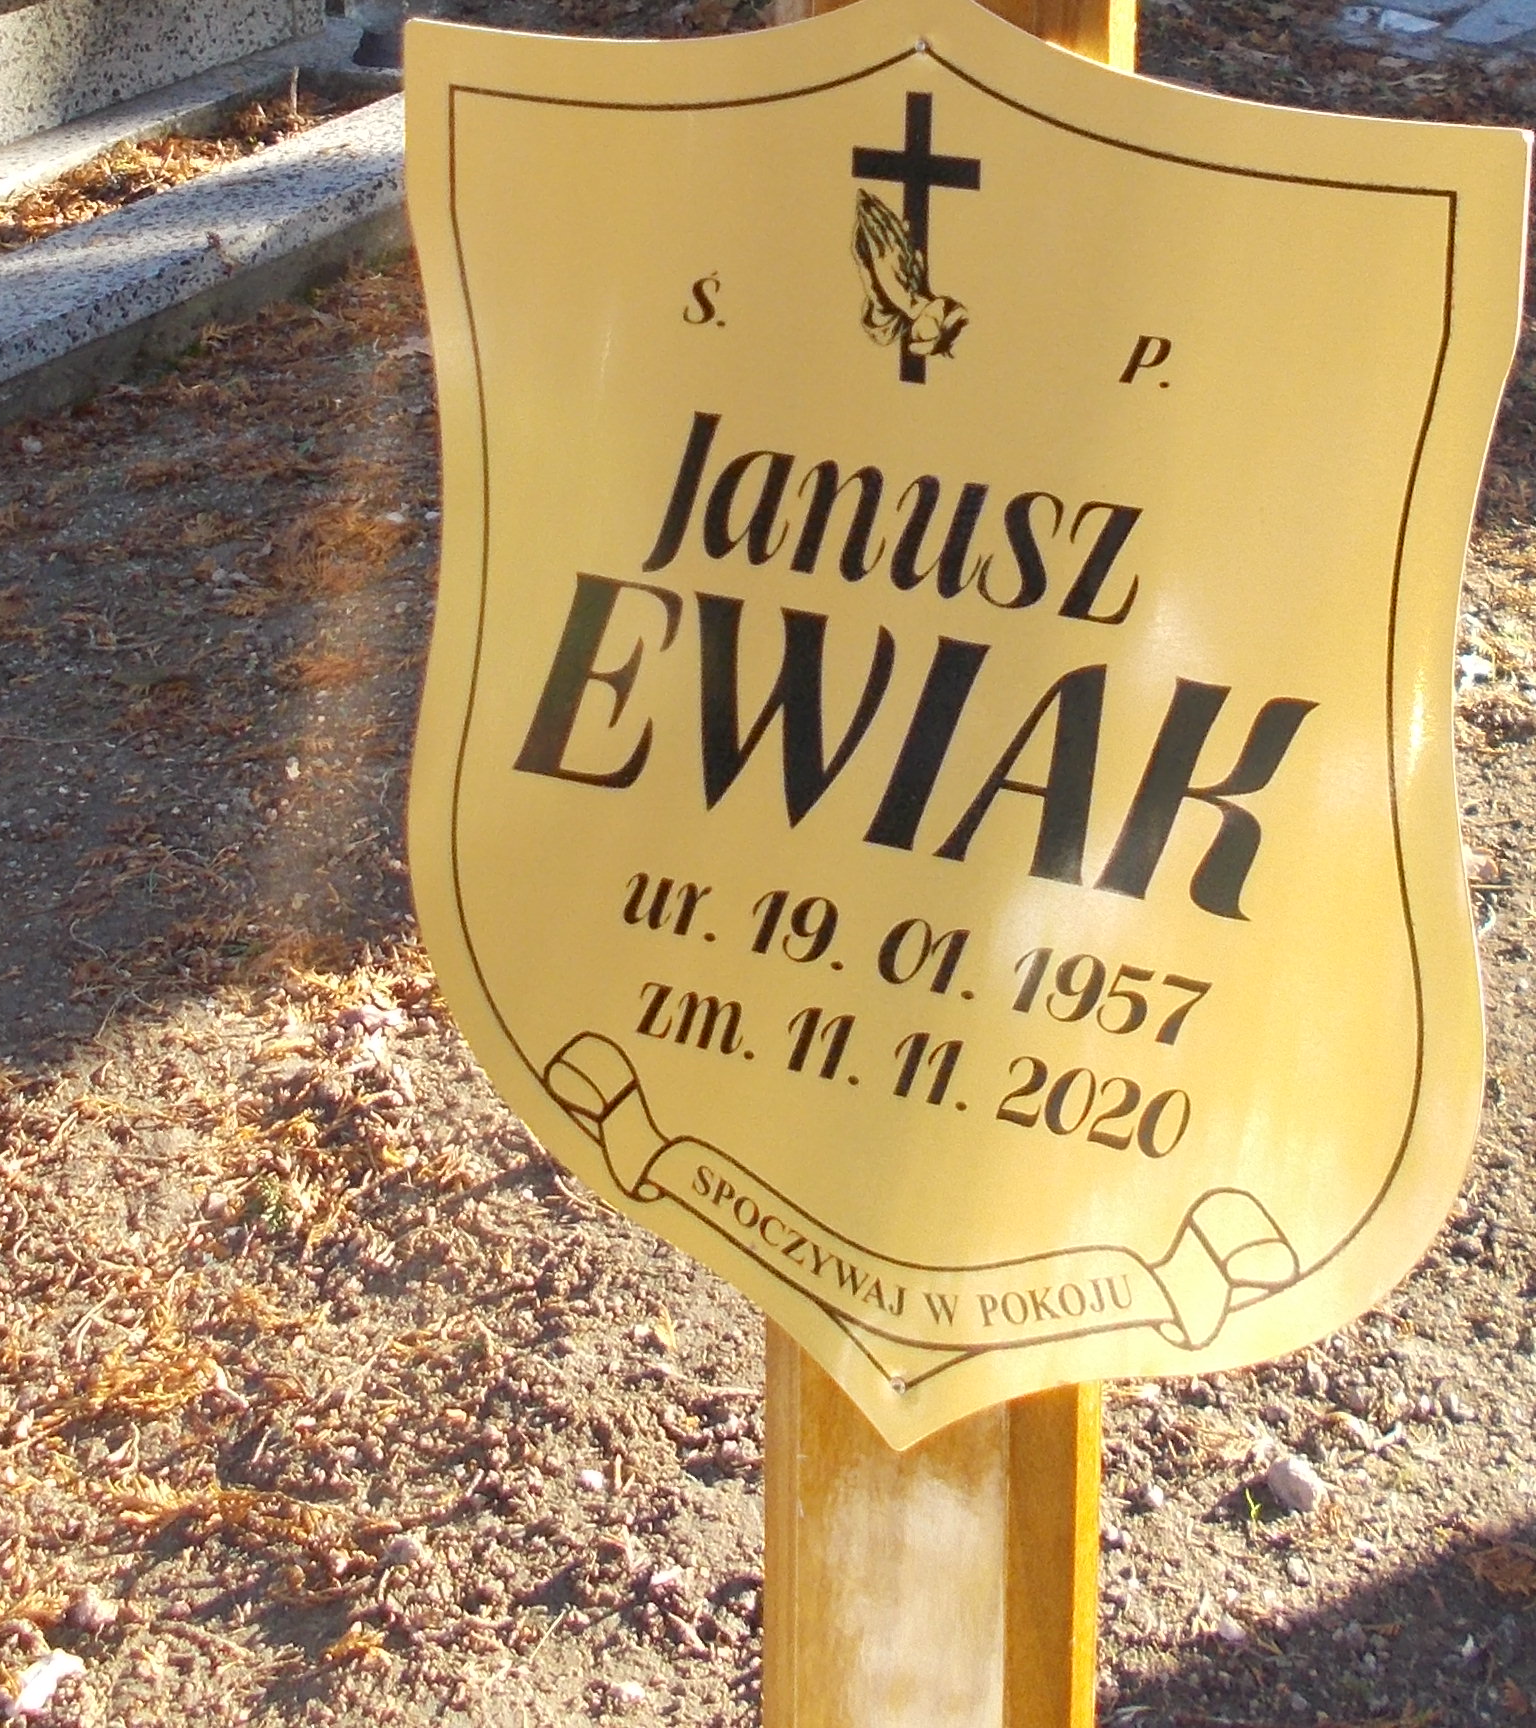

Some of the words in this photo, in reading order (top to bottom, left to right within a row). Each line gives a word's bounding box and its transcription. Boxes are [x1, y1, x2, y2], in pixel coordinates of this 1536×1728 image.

[682, 270, 727, 329] Ś.
[1118, 334, 1173, 390] P.
[642, 410, 1145, 627] Janusz
[512, 571, 1322, 923] EWIAK
[623, 872, 718, 946] ur.
[750, 889, 846, 974] 19.
[876, 917, 976, 1003] 01.
[1011, 951, 1214, 1048] 1957
[636, 981, 756, 1063] zm.
[786, 1006, 861, 1089] 11.
[892, 1031, 970, 1114] 11.
[995, 1055, 1192, 1162] 2020
[691, 1164, 906, 1317] SPOCZYWAJ
[922, 1291, 960, 1327] W
[975, 1273, 1134, 1328] POKOJU
